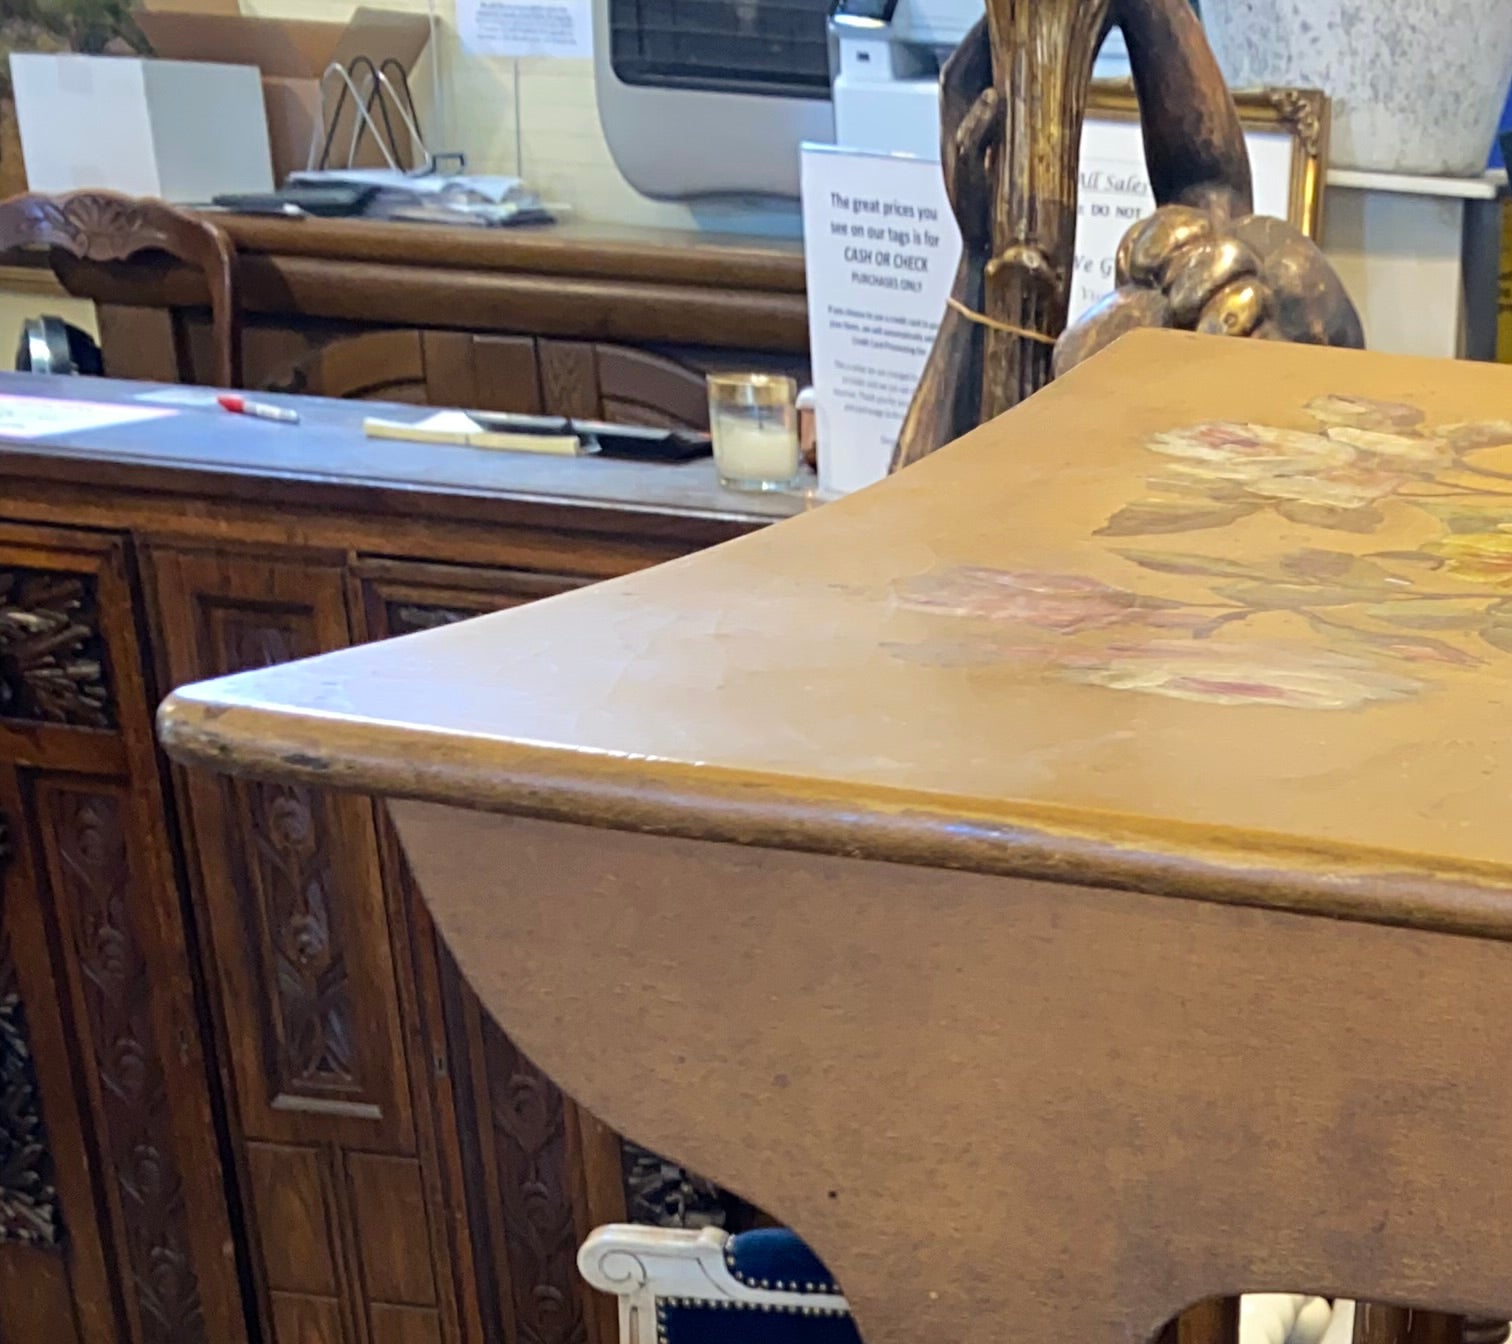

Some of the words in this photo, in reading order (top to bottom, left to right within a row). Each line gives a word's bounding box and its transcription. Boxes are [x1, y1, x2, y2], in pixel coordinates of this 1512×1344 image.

[831, 192, 849, 209] The
[853, 197, 879, 214] great
[883, 200, 914, 218] prices
[918, 207, 937, 222] you
[1091, 204, 1110, 217] DO
[1116, 206, 1142, 219] NOT
[831, 221, 847, 236] see
[851, 225, 864, 237] on
[867, 227, 884, 240] our
[888, 227, 910, 247] tags
[913, 228, 921, 245] is
[924, 229, 939, 247] for
[844, 246, 872, 264] CASH
[875, 250, 890, 266] OR
[894, 253, 928, 272] CHECK
